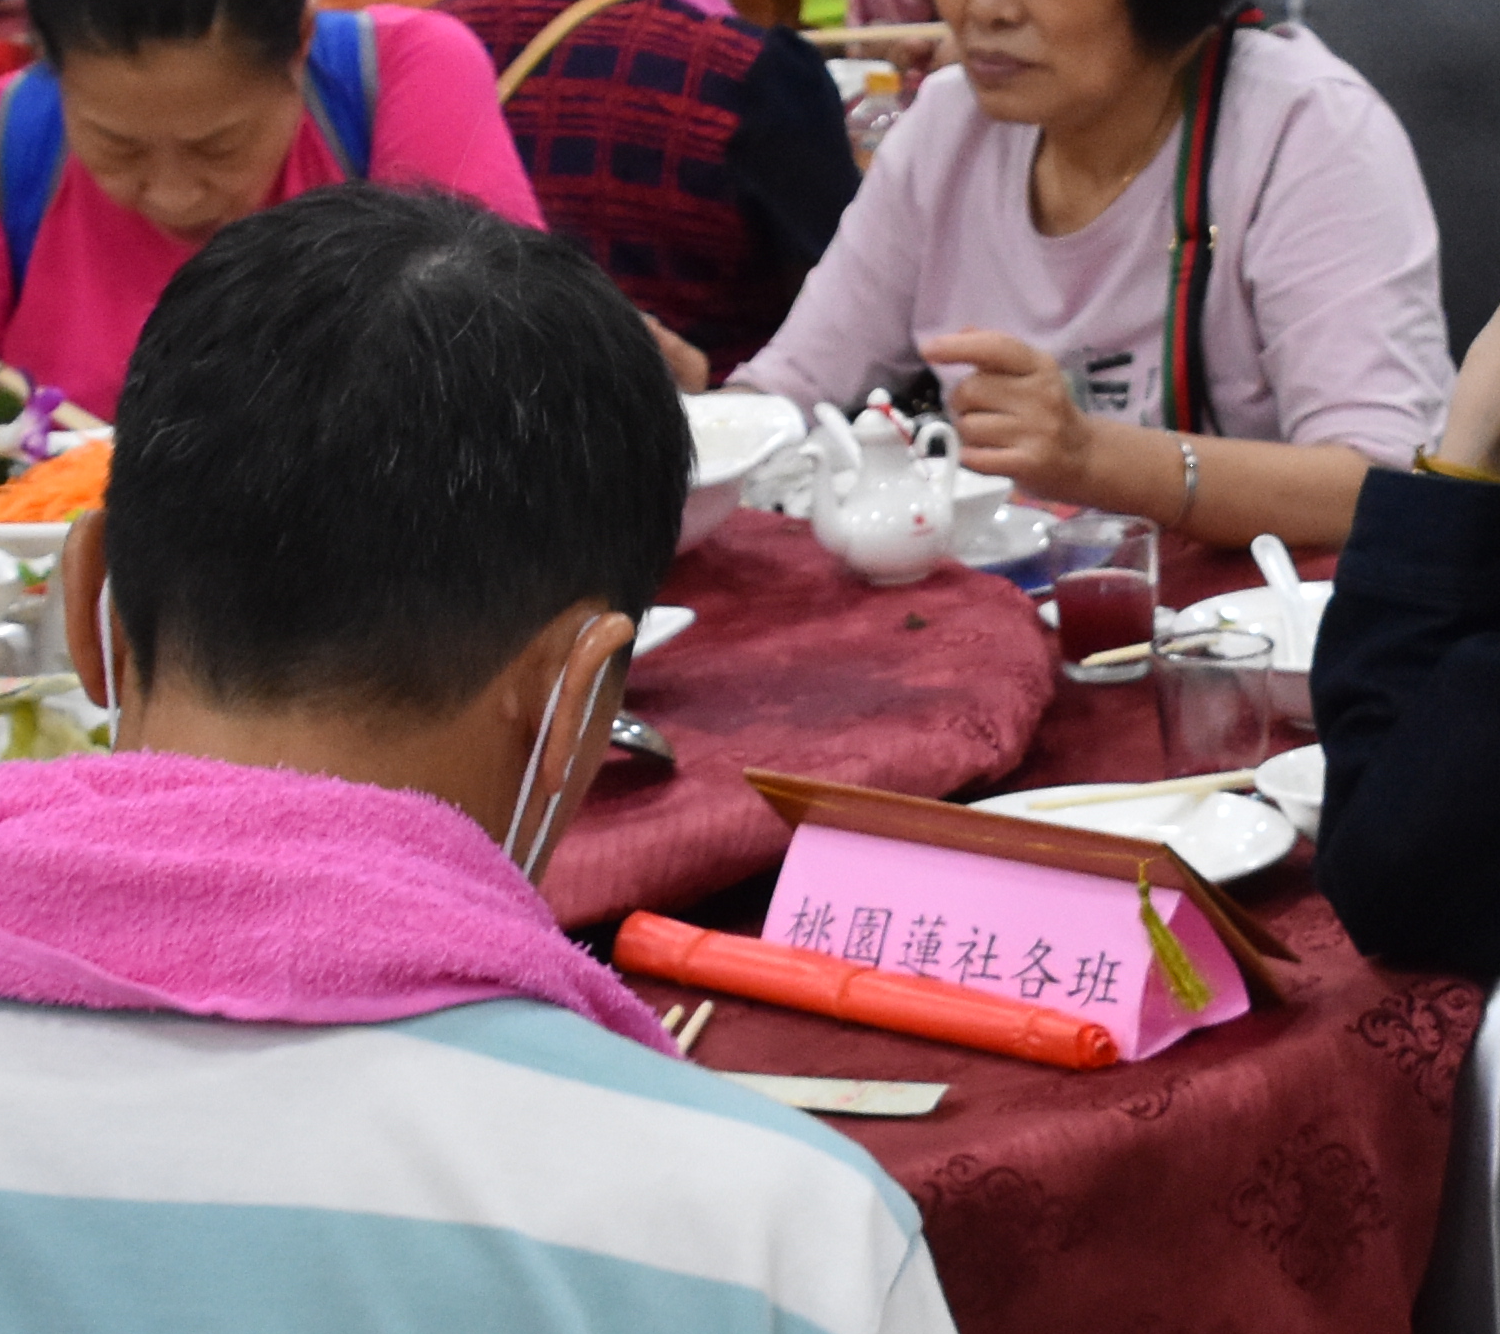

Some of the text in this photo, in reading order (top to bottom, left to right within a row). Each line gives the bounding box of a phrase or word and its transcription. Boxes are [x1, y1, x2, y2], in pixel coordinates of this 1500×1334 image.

[785, 895, 1123, 1008] 桃園蓮社各班
